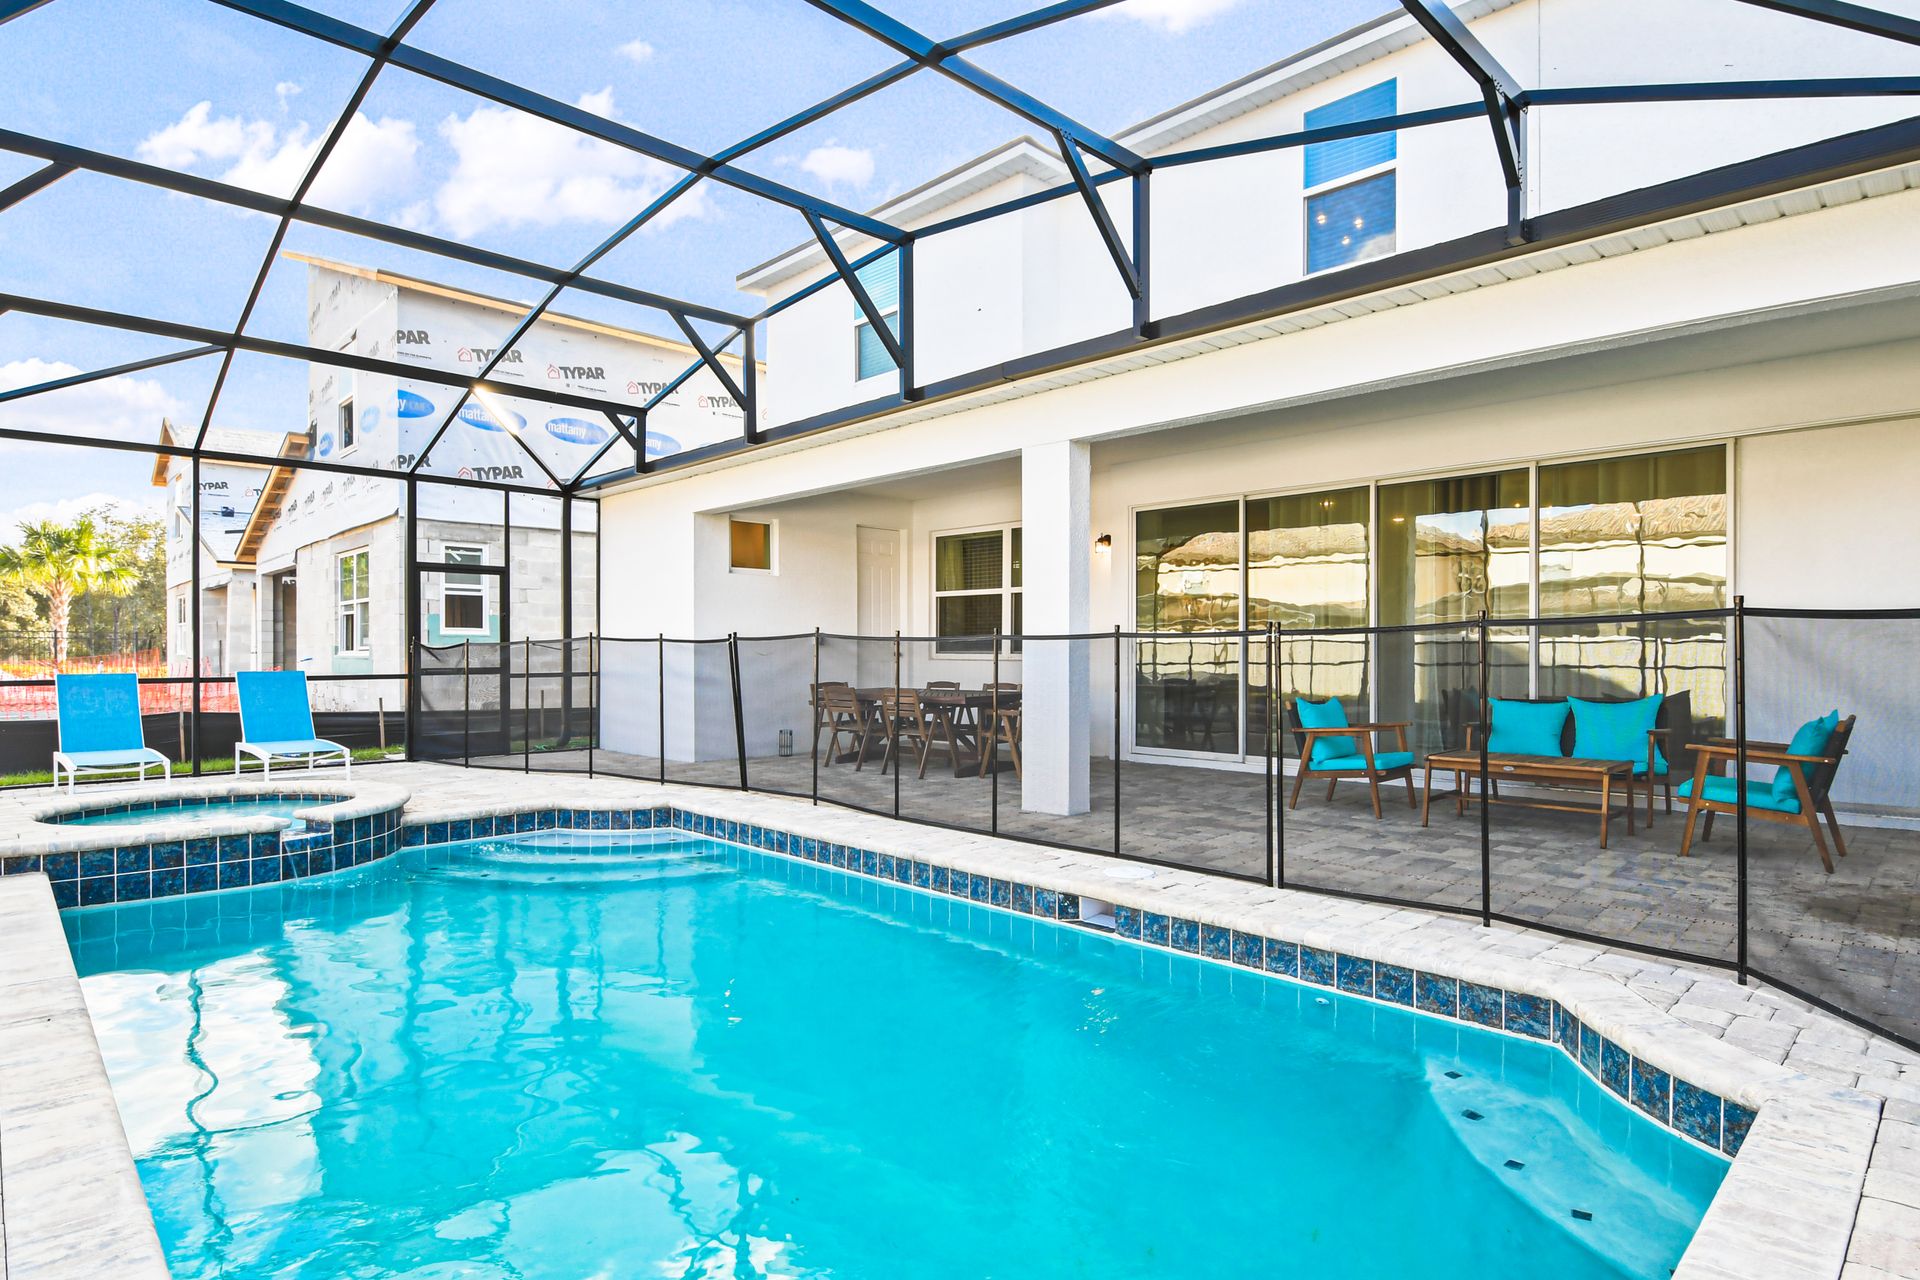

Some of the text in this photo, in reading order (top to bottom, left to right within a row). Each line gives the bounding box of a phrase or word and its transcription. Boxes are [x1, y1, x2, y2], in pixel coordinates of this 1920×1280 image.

[396, 329, 431, 345] PAR
[471, 348, 523, 363] TYAR
[559, 366, 606, 380] TYPAR
[638, 382, 679, 395] TYP
[708, 396, 741, 408] TYPA
[547, 422, 586, 439] mattamy
[472, 465, 524, 480] TYPAR
[199, 481, 229, 491] YPAR
